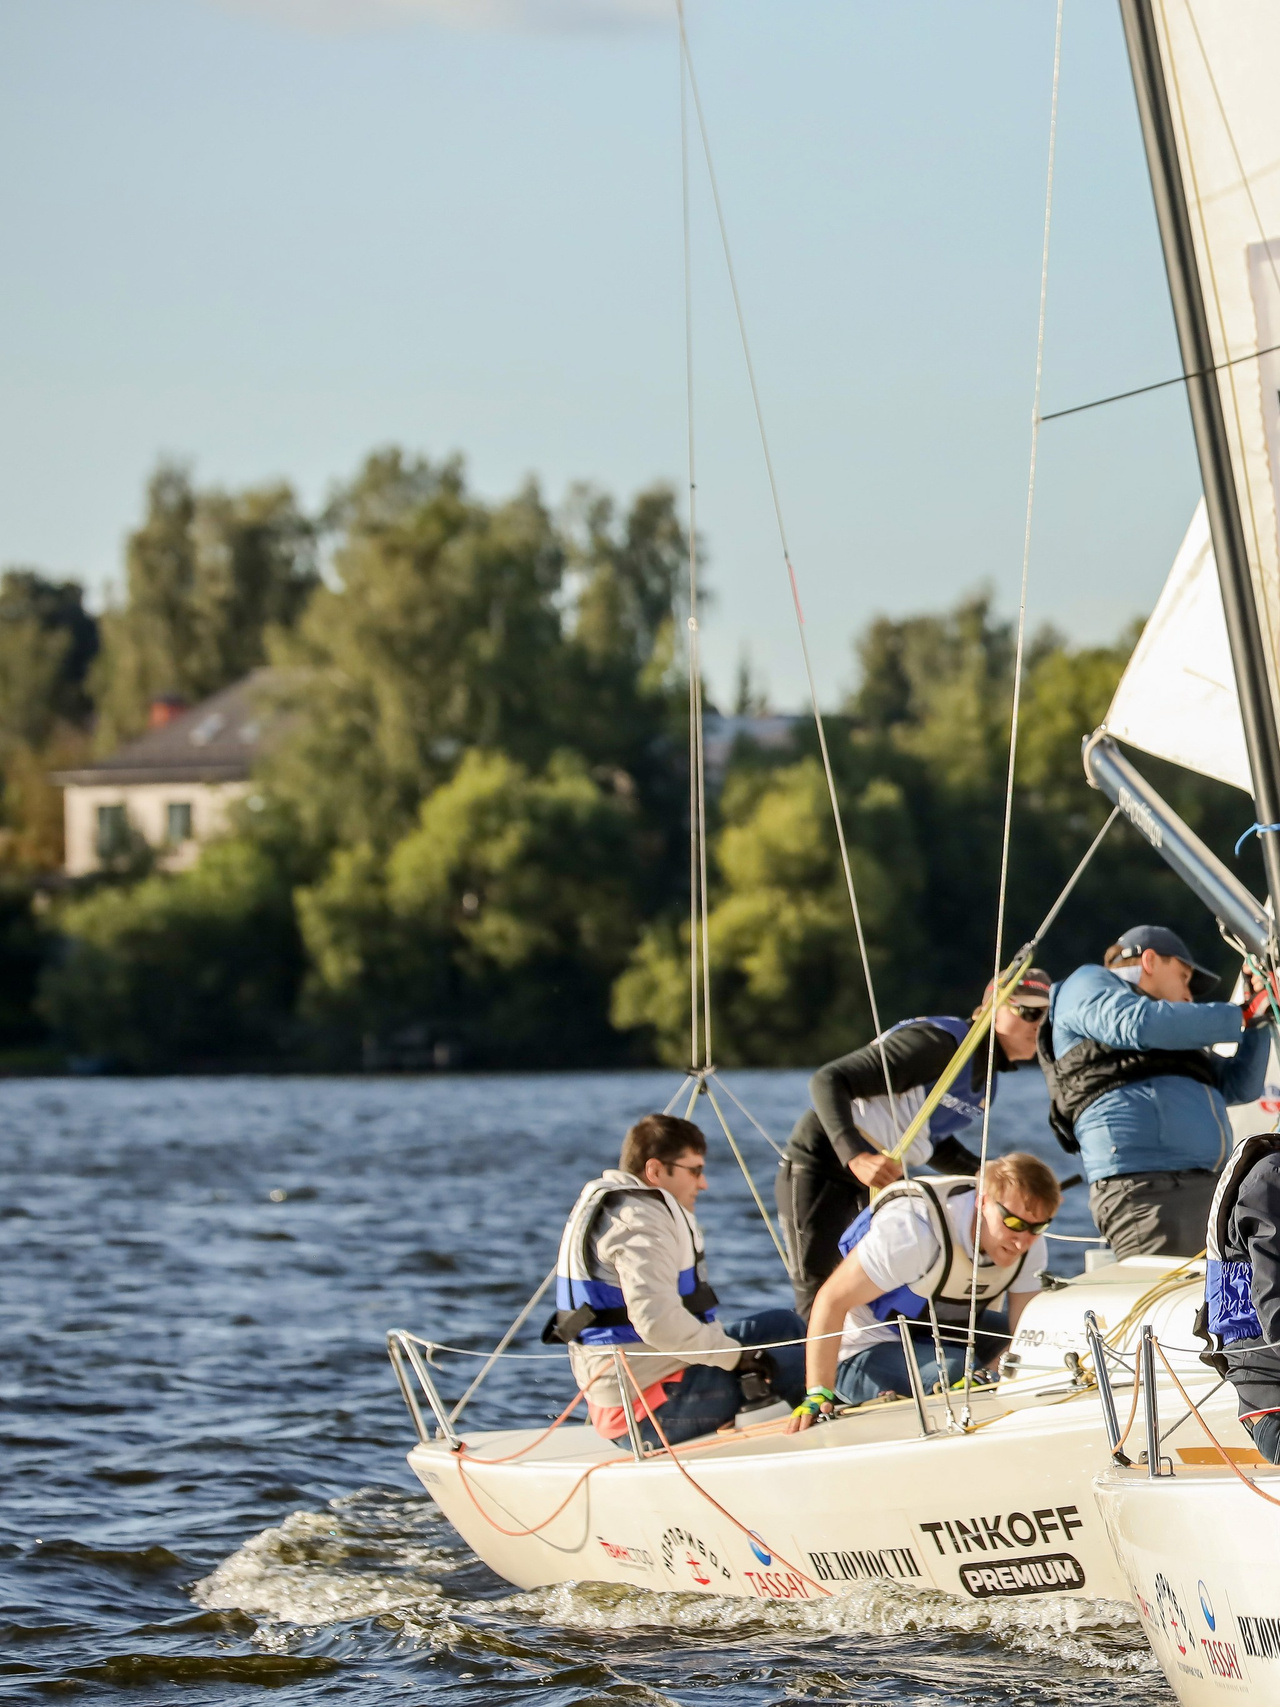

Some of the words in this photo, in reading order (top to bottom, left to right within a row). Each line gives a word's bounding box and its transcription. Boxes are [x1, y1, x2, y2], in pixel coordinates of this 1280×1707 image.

[919, 1505, 1083, 1555] TINKOFF
[807, 1548, 923, 1582] ВЕДОМОСТИ
[963, 1560, 1080, 1593] PREMIUM
[744, 1572, 810, 1599] TASSAY
[1201, 1638, 1243, 1680] TASSAY
